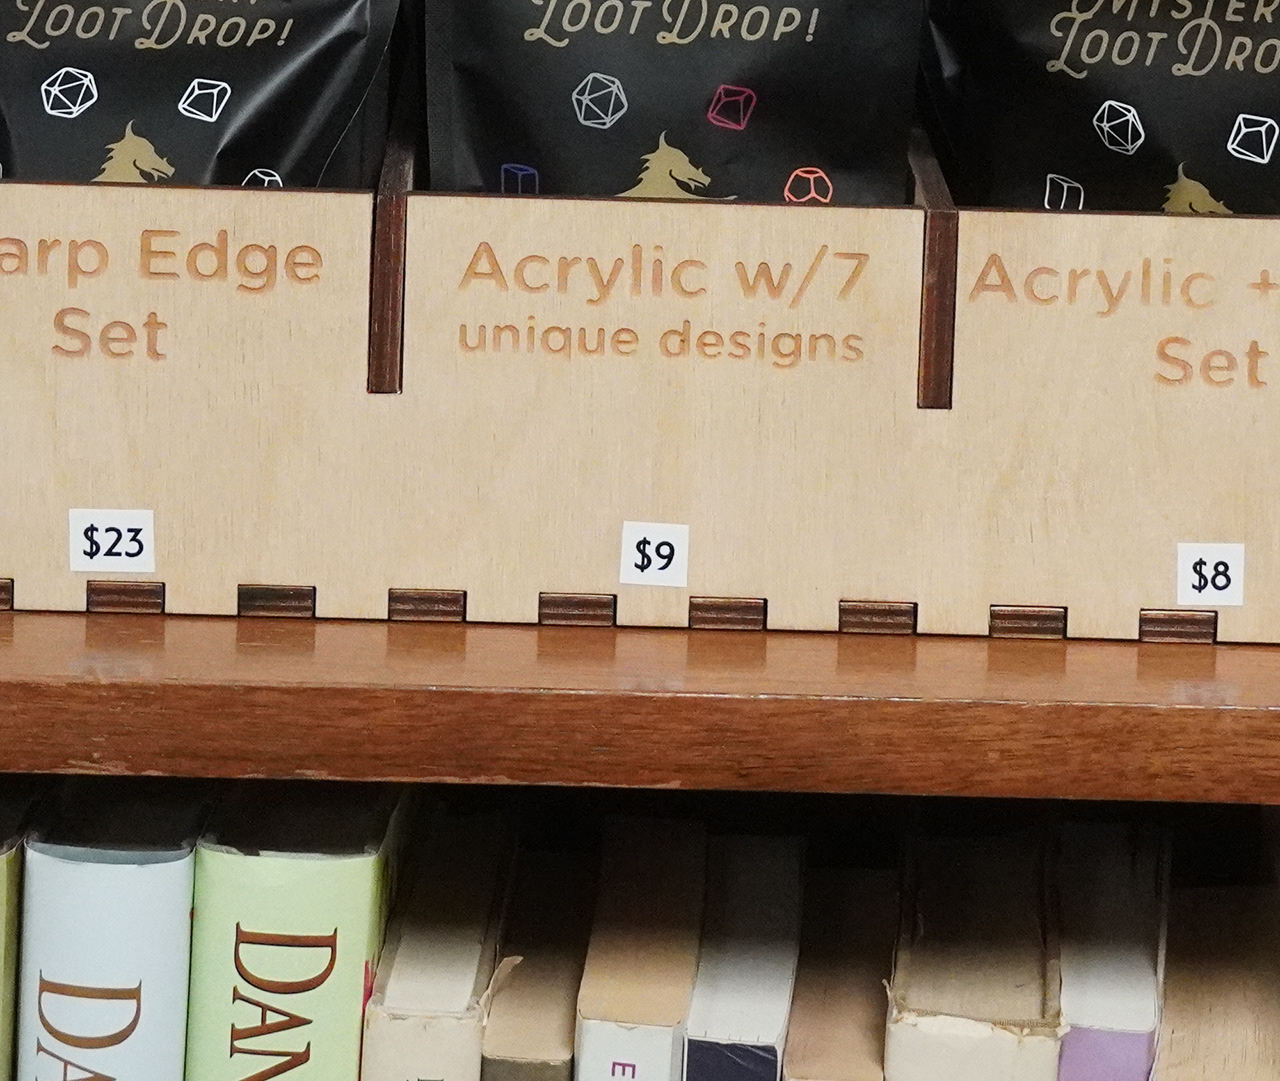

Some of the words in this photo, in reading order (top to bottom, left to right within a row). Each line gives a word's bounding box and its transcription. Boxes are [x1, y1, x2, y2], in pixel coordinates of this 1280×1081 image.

[1046, 12, 1168, 79] LOOT
[140, 229, 323, 293] Edge
[458, 241, 708, 306] Acrylic
[734, 245, 871, 309] w/7
[968, 253, 1216, 318] Acrylic
[1246, 268, 1280, 301] +
[52, 307, 168, 361] Set
[458, 316, 639, 363] unique
[659, 320, 865, 369] designs
[1154, 336, 1270, 389] Set
[82, 524, 144, 560] $23
[634, 537, 676, 573] $9
[1191, 558, 1231, 593] $8
